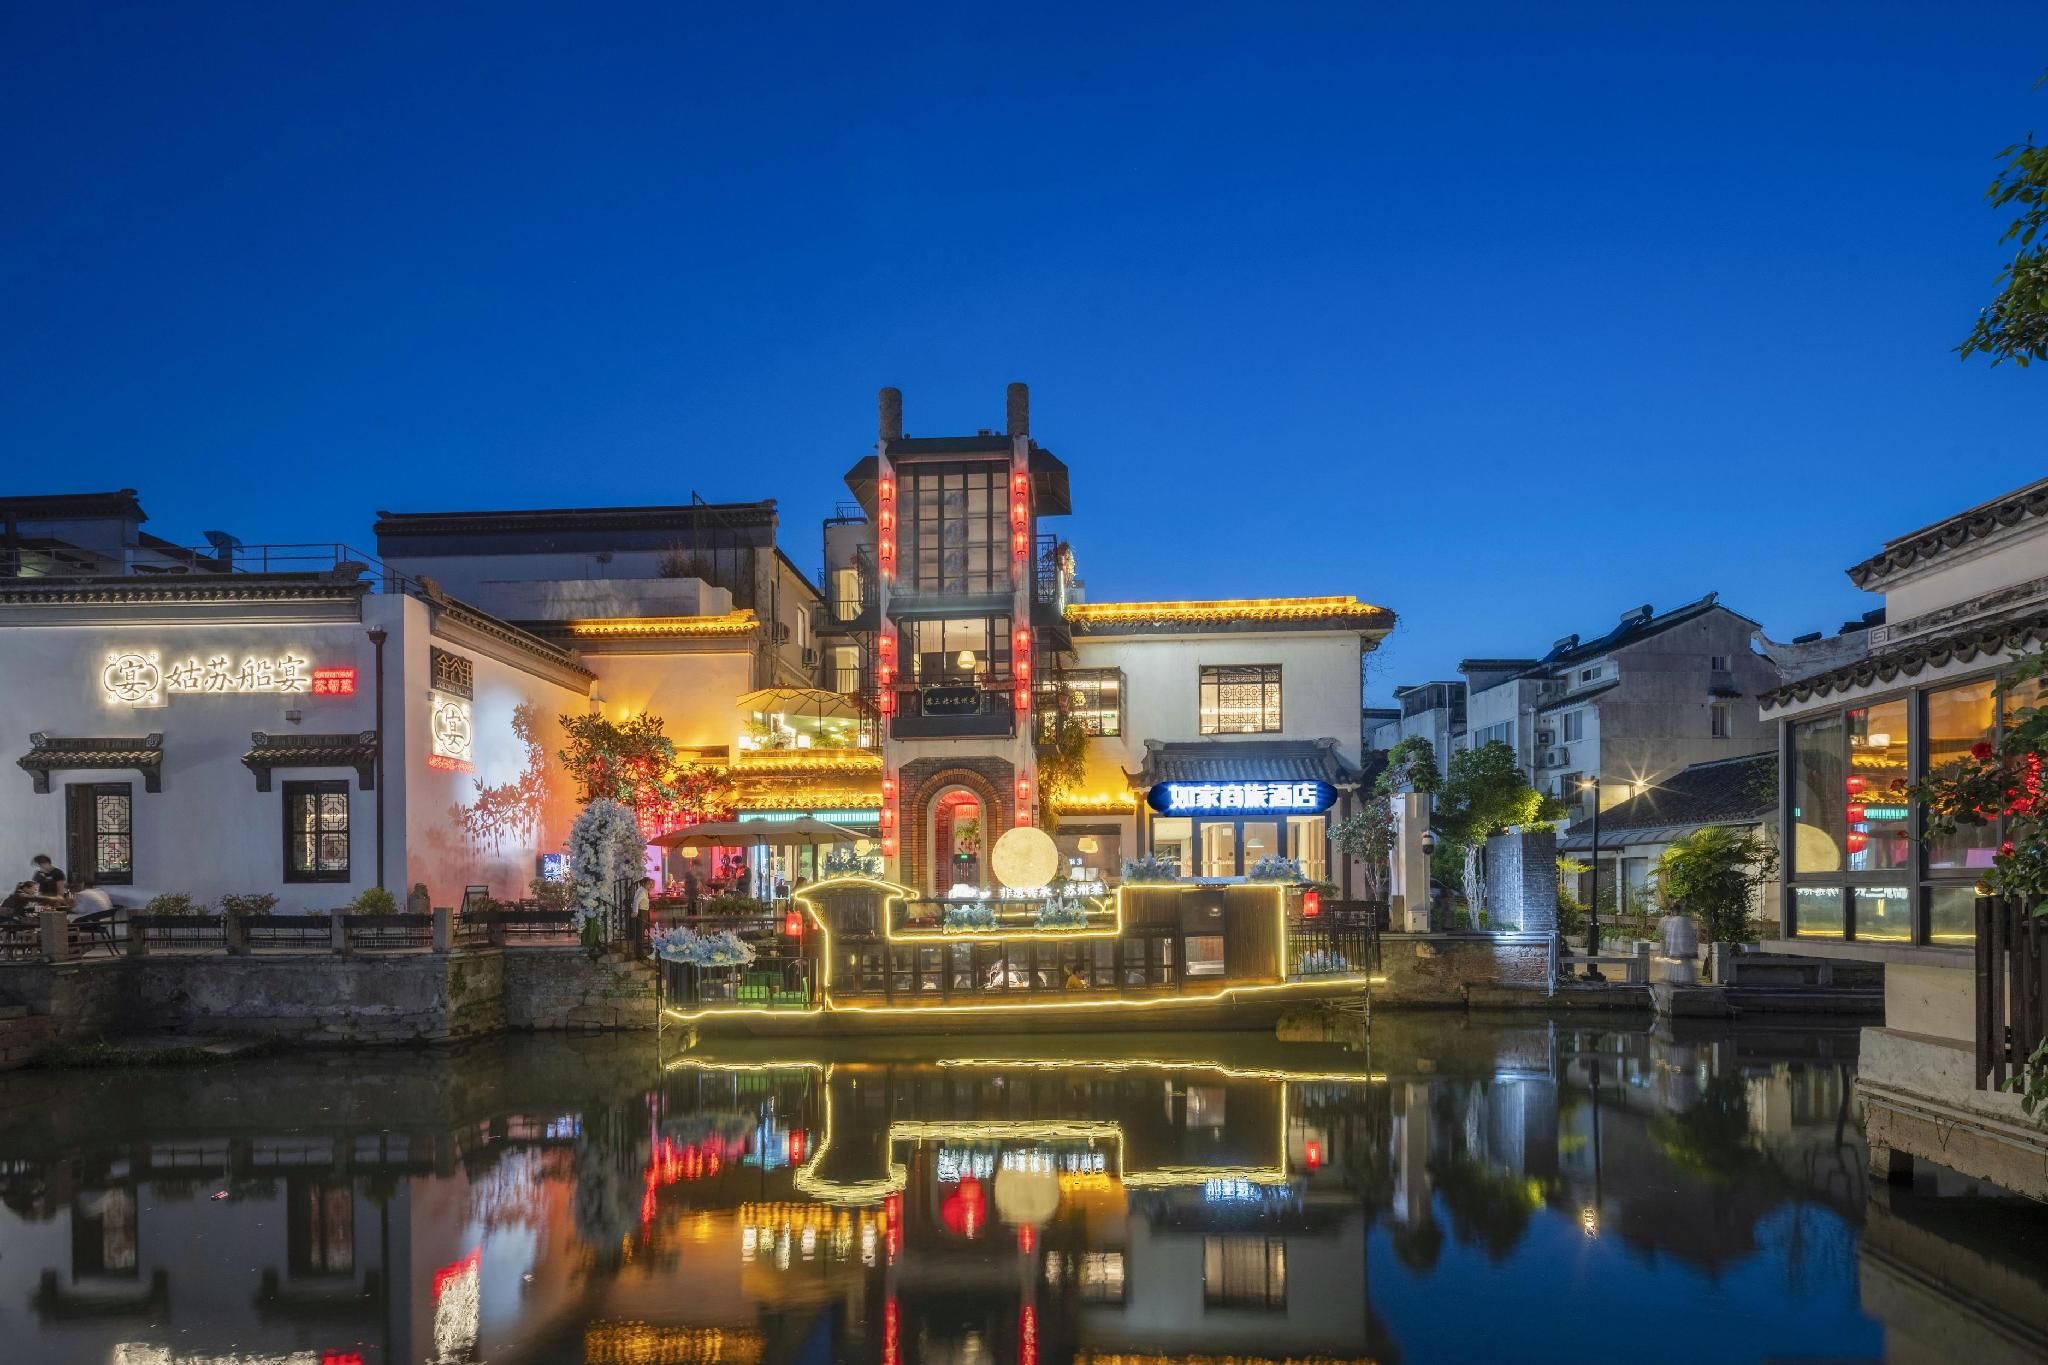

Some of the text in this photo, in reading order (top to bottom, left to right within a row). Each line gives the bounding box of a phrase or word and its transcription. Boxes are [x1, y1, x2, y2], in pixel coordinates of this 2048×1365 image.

[115, 660, 147, 694] 宴
[164, 655, 308, 692] 姑苏船宴
[443, 709, 465, 748] 宴
[1168, 783, 1318, 809] 如家商旅酒店
